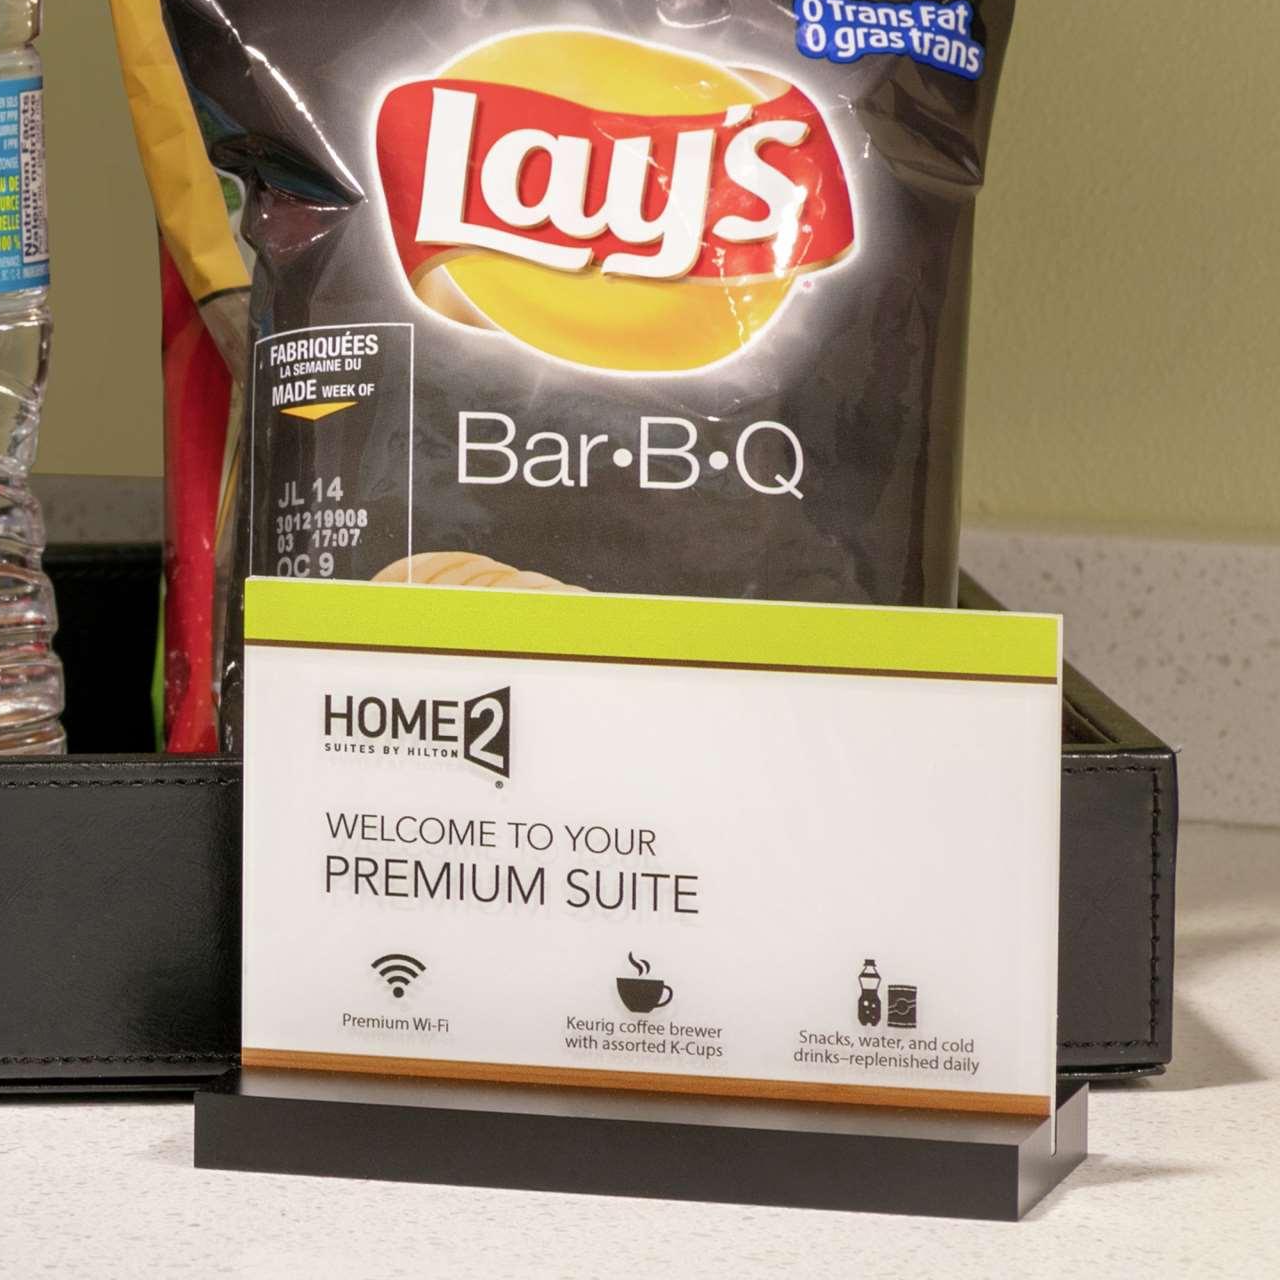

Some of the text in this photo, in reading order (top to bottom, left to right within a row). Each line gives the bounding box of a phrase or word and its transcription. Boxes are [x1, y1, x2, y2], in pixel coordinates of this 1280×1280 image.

[826, 0, 915, 28] Trans
[919, 3, 969, 35] Fat
[805, 23, 981, 73] 0 gras trans
[414, 86, 811, 281] Lay's
[270, 331, 379, 367] FABRIQUÉES
[279, 358, 362, 379] LA SEMAINE DU
[272, 379, 376, 407] MADE WEEK OF
[278, 476, 344, 509] JL 14
[275, 507, 368, 534] 301219908
[277, 527, 361, 554] 03 17:07
[318, 551, 335, 577] 9
[324, 742, 459, 758] SUITES BY HILTON
[325, 811, 657, 857] WELCOME TO YOUR
[325, 855, 700, 914] PREMIUM SUITE
[342, 1013, 450, 1033] Premium Wi-Fi
[566, 1016, 723, 1039] Keurig coffee brewer
[565, 1035, 724, 1060] with assorted K-Cups
[799, 1030, 975, 1053] Snacks, water, and cold
[943, 1056, 980, 1076] daily
